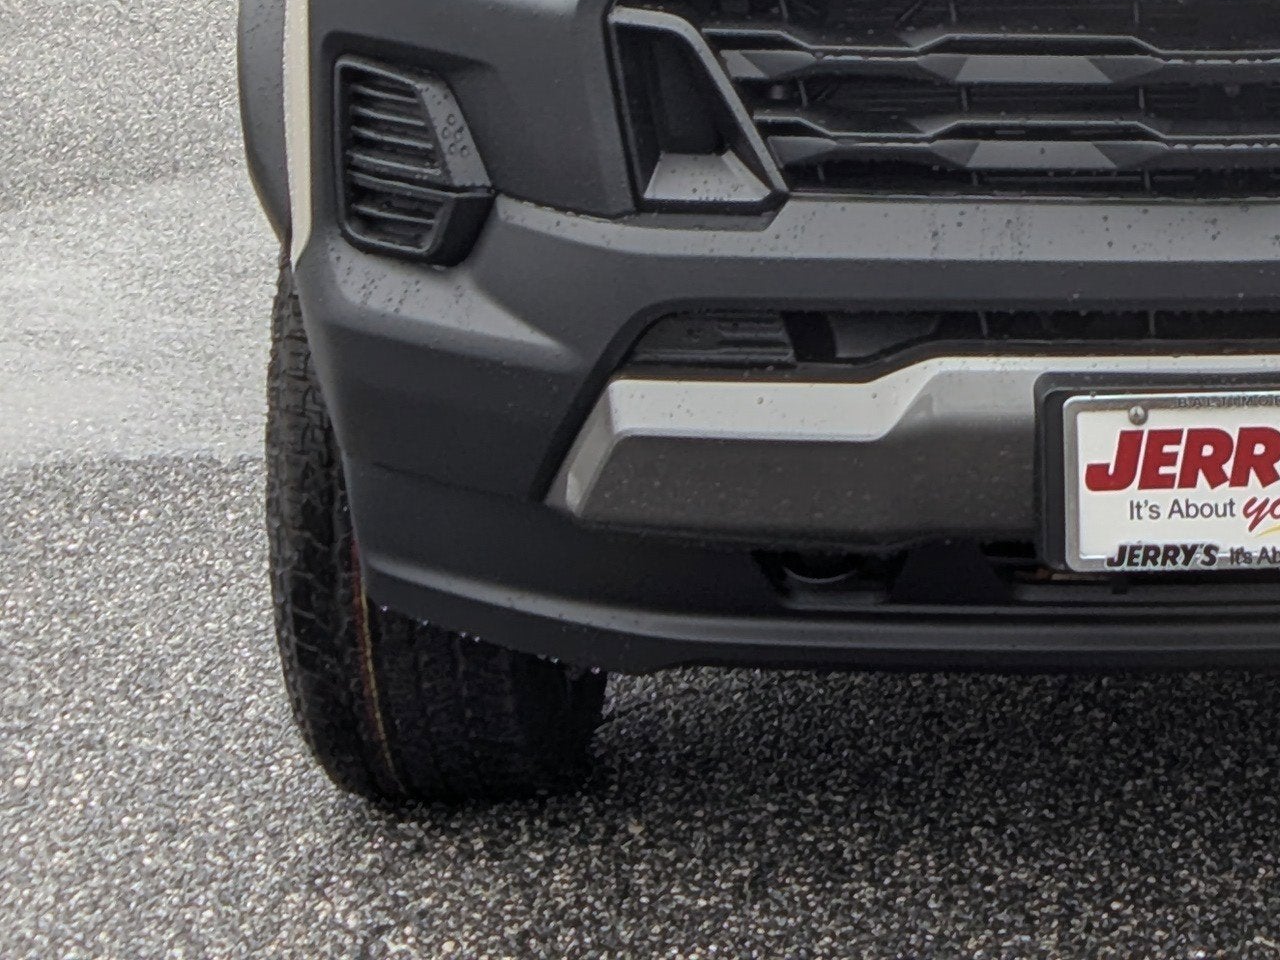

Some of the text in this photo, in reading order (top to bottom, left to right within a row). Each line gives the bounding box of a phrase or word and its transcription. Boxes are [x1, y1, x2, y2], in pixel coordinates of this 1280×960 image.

[1129, 499, 1161, 520] It's
[1168, 497, 1236, 519] About
[1106, 543, 1220, 568] JERRY'S
[1229, 547, 1253, 565] It's
